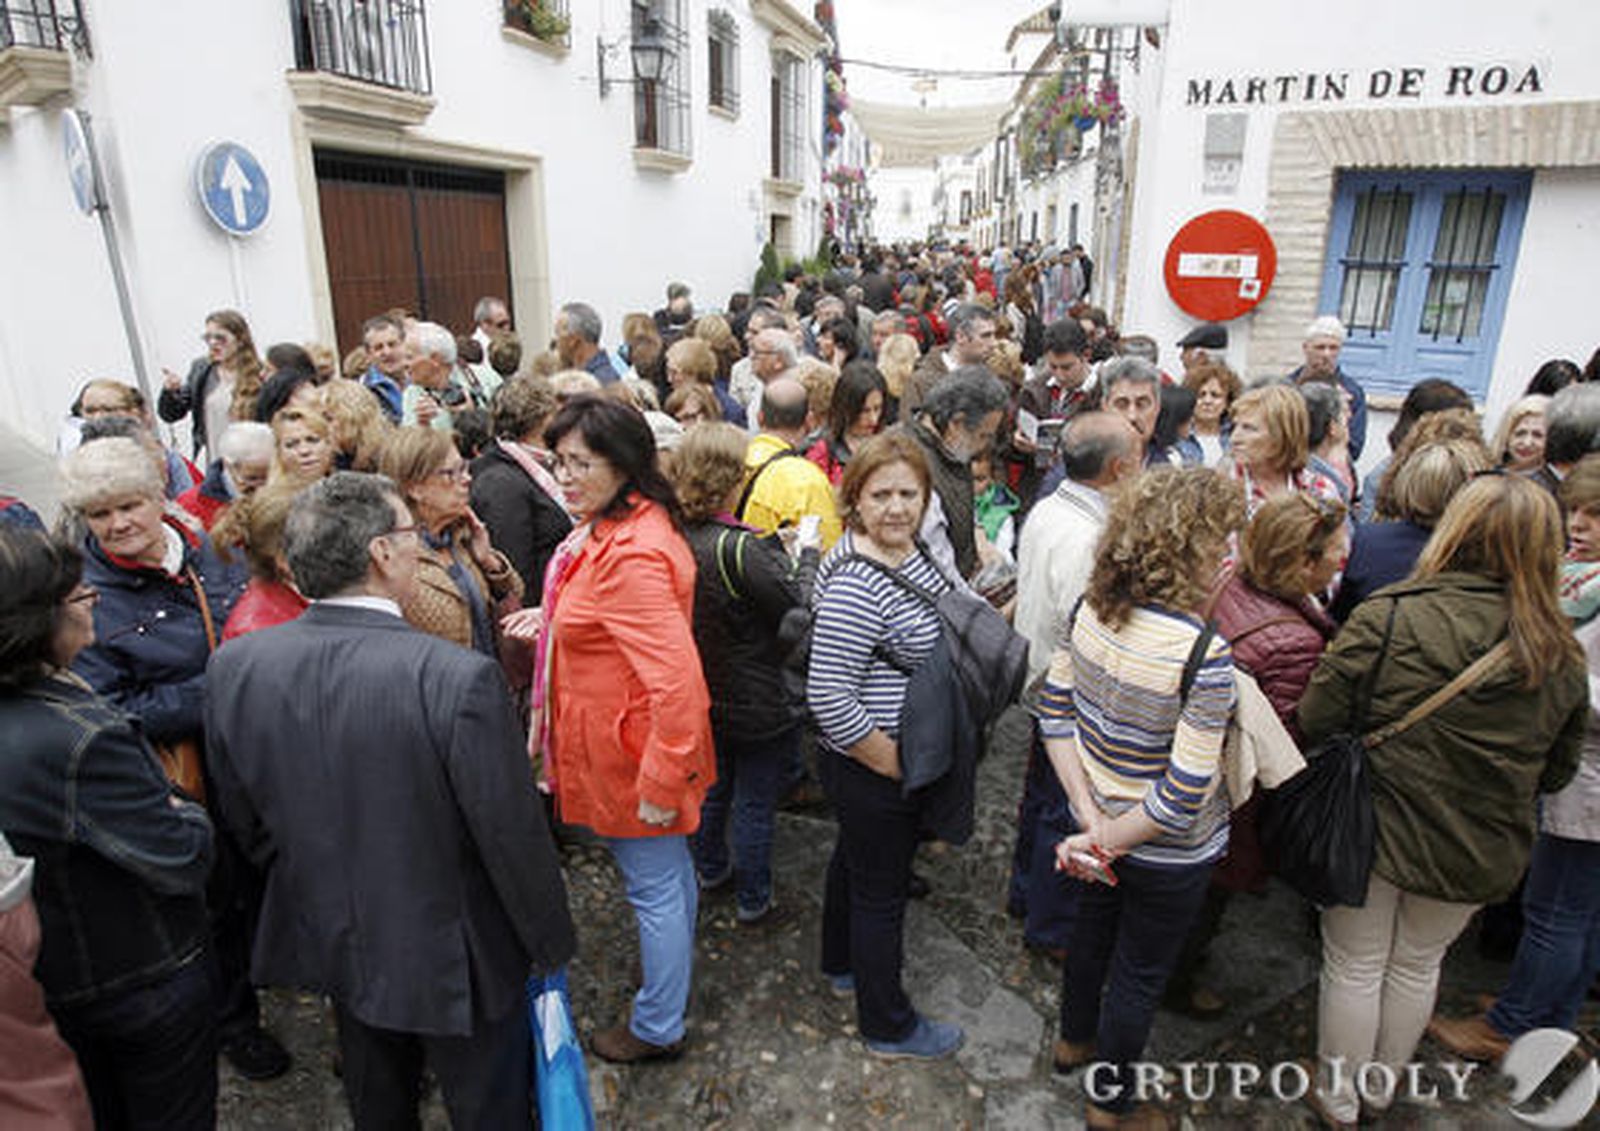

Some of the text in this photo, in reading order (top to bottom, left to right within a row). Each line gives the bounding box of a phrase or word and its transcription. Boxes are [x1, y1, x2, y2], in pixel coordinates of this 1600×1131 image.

[1186, 65, 1542, 106] MARTIN DE ROA
